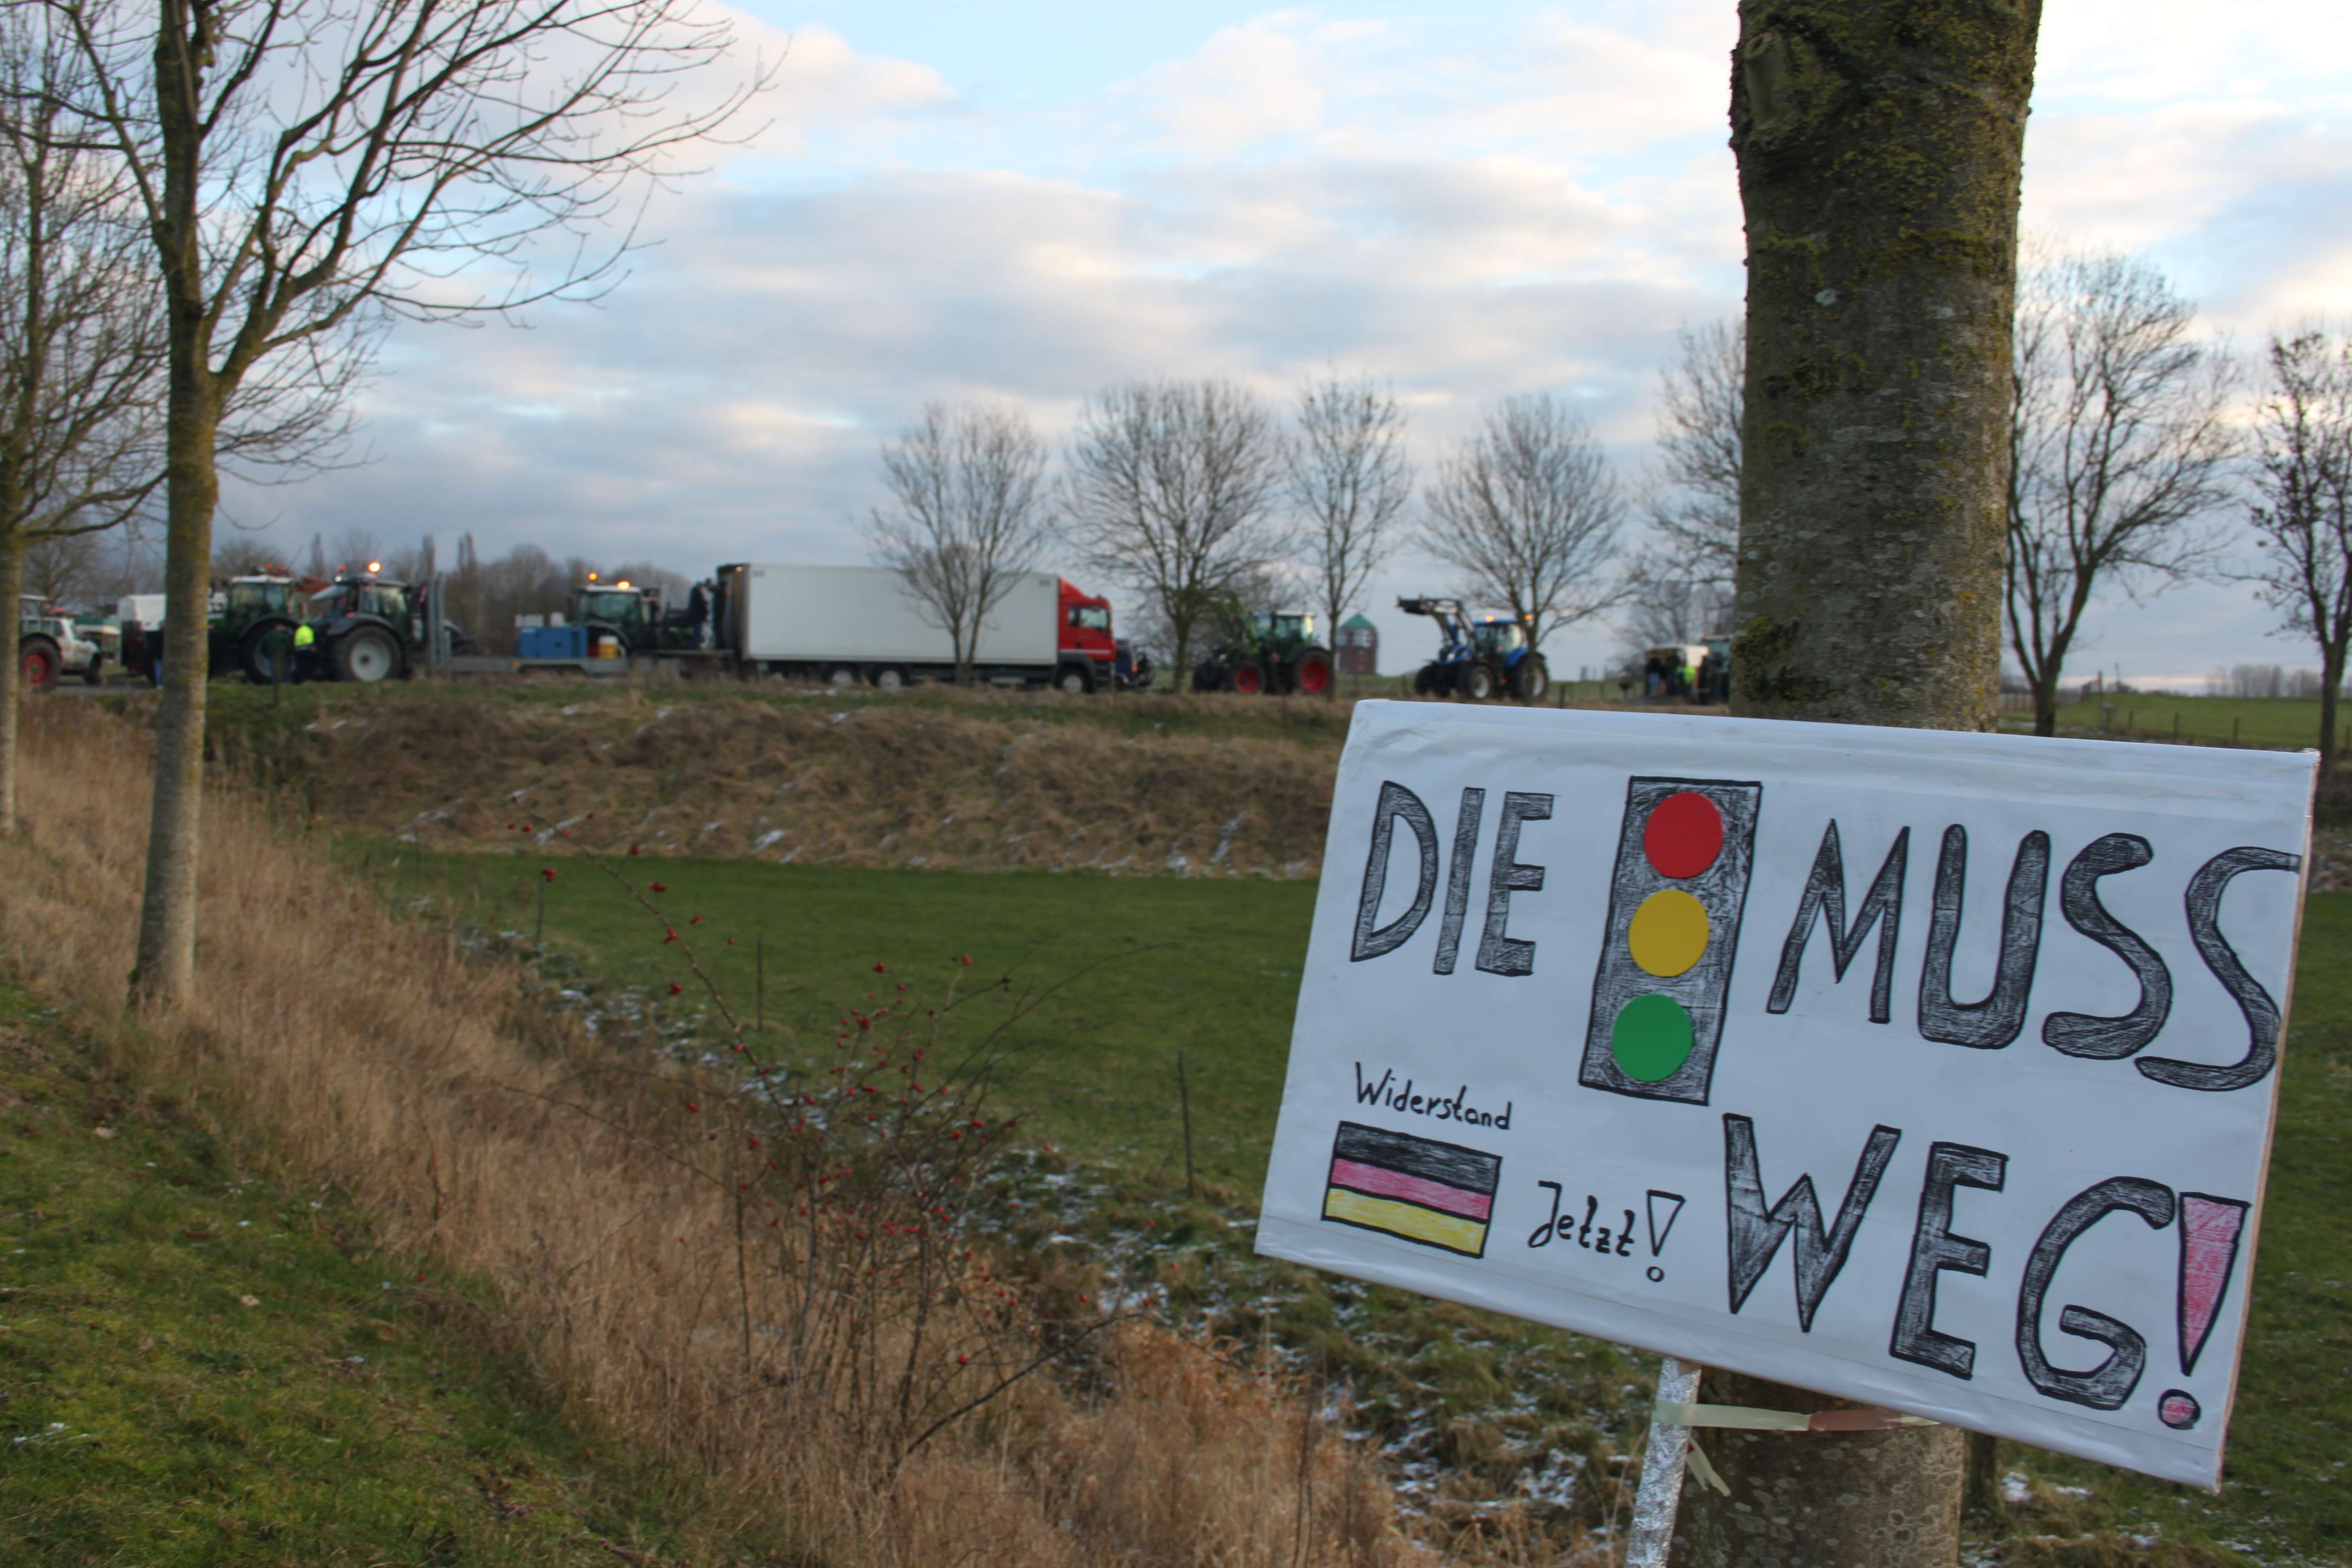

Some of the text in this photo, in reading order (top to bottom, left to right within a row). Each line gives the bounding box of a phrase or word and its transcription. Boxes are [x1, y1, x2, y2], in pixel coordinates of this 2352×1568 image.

[1350, 780, 2301, 1091] DIE MUSS
[1355, 1062, 1512, 1130] Widerstand
[1722, 1113, 2251, 1430] WEG!
